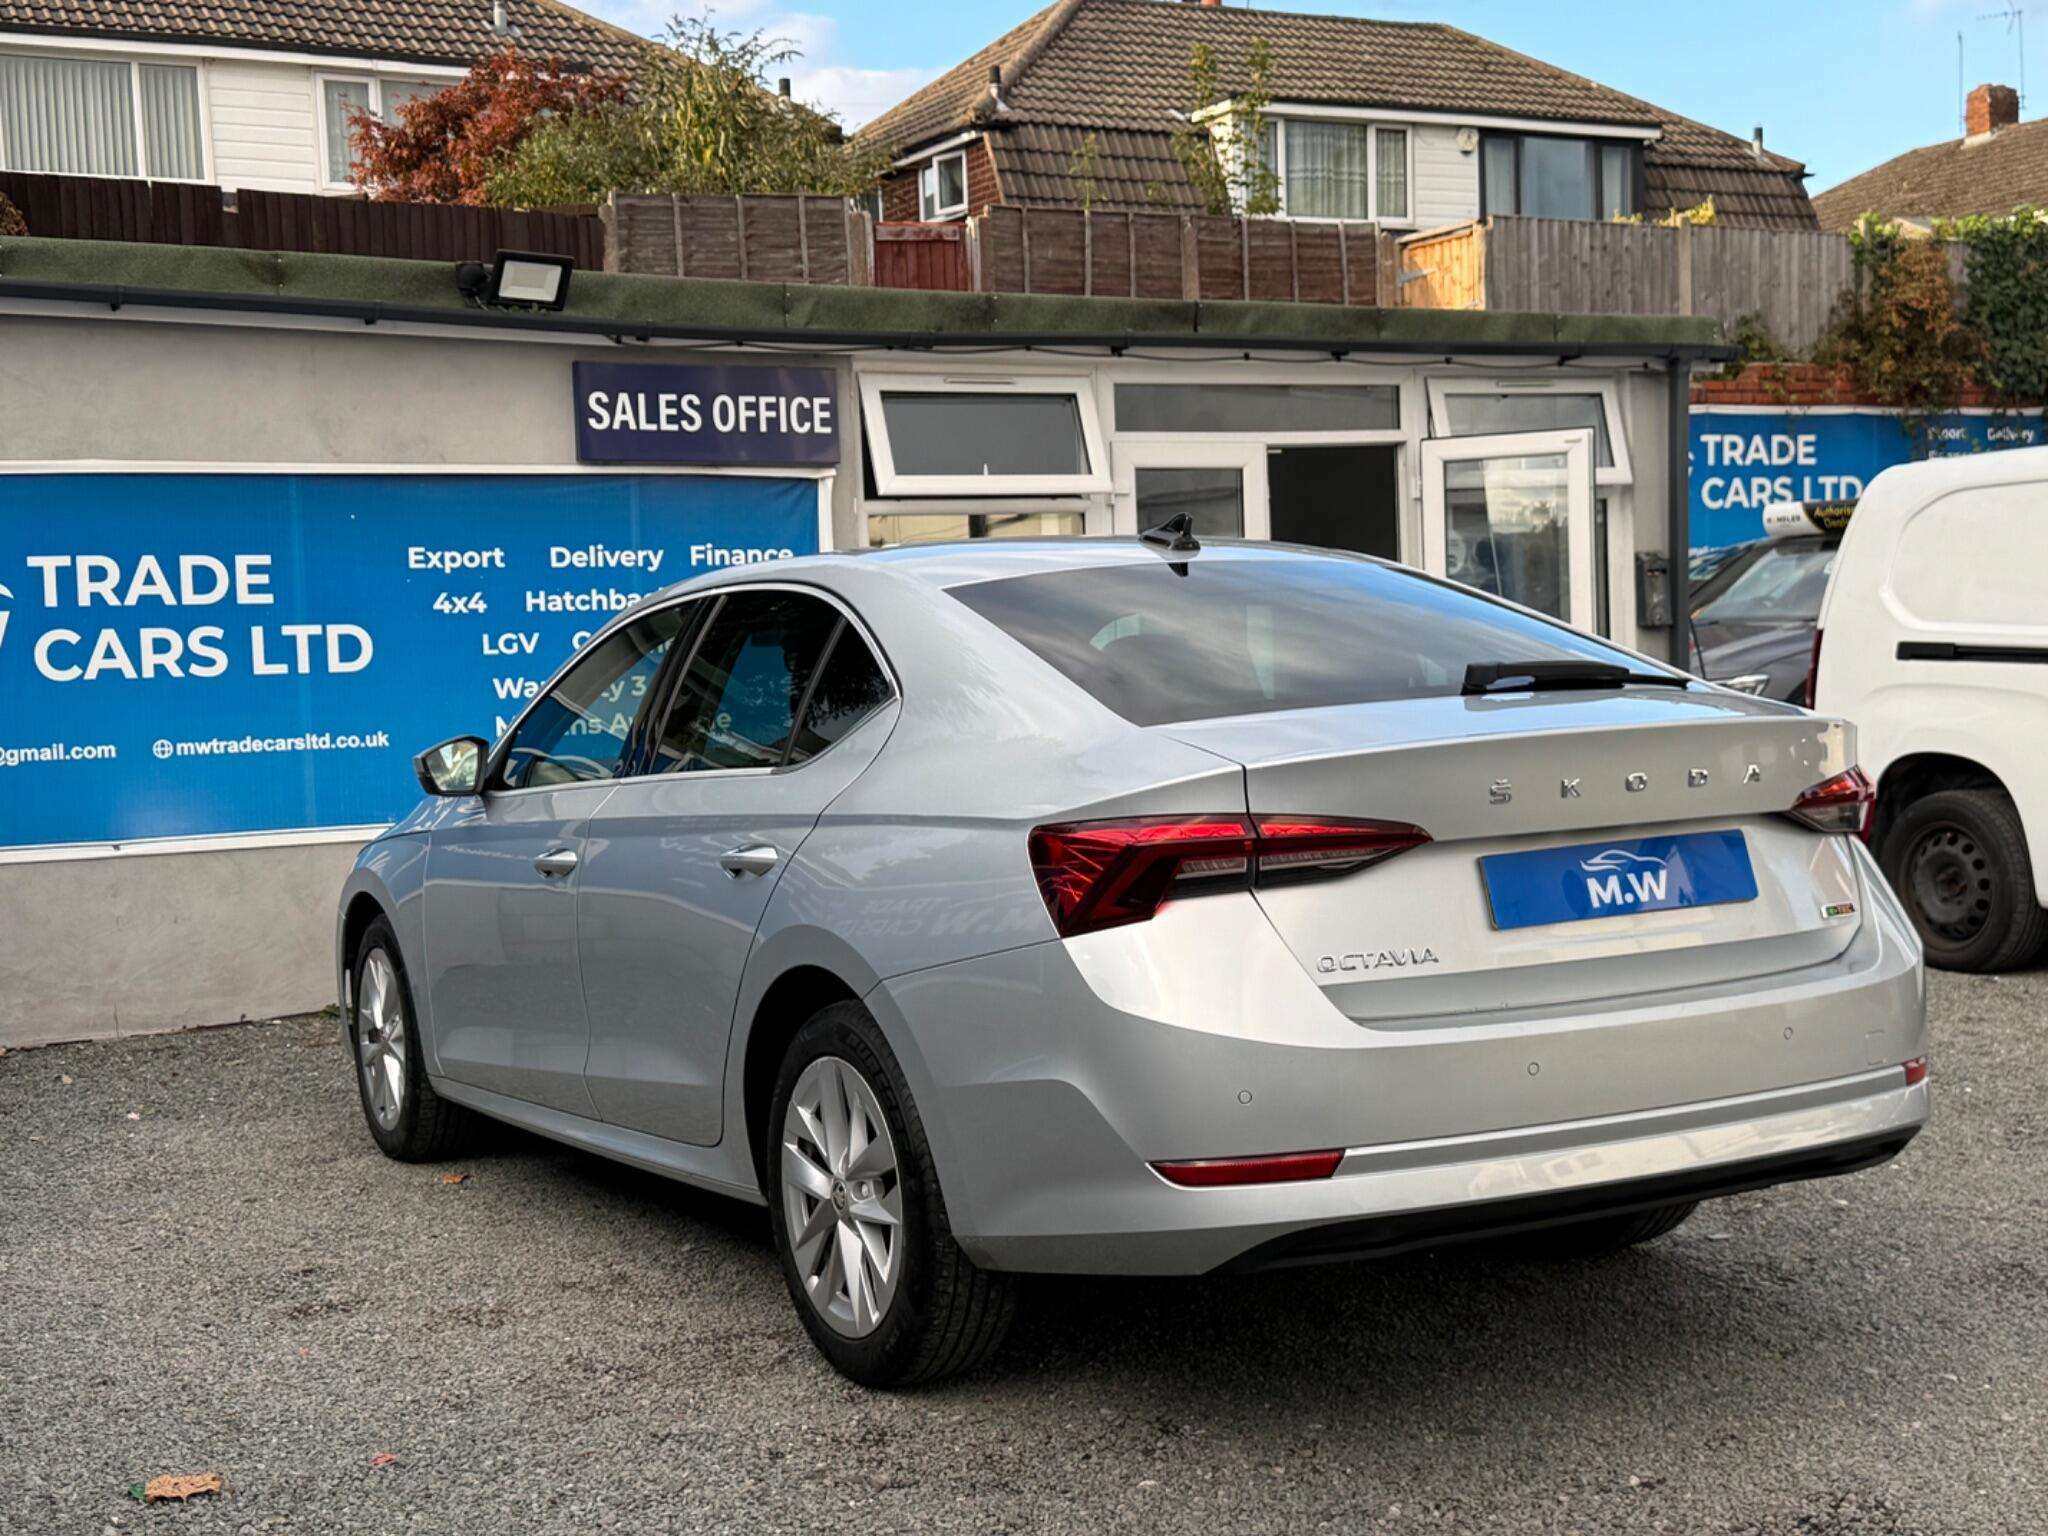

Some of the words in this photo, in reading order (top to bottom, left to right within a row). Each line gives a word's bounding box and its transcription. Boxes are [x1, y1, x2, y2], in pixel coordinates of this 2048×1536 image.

[587, 390, 703, 433] SALES
[712, 394, 833, 435] OFFICE
[1699, 433, 1818, 467] TRADE
[1700, 475, 1794, 510] CARS
[1802, 474, 1864, 503] LTD
[408, 546, 506, 573] Export
[549, 545, 664, 571] Delivery
[26, 554, 275, 608] TRADE
[432, 592, 488, 614] 4x4
[525, 587, 663, 613] Hatchba
[33, 626, 229, 682] CARS
[250, 623, 374, 676] LTD
[482, 632, 540, 656] LGV
[176, 731, 390, 756] mwtradecarsltd.co.uk
[1586, 868, 1668, 909] M.W
[1317, 946, 1440, 973] OCTAVIA
